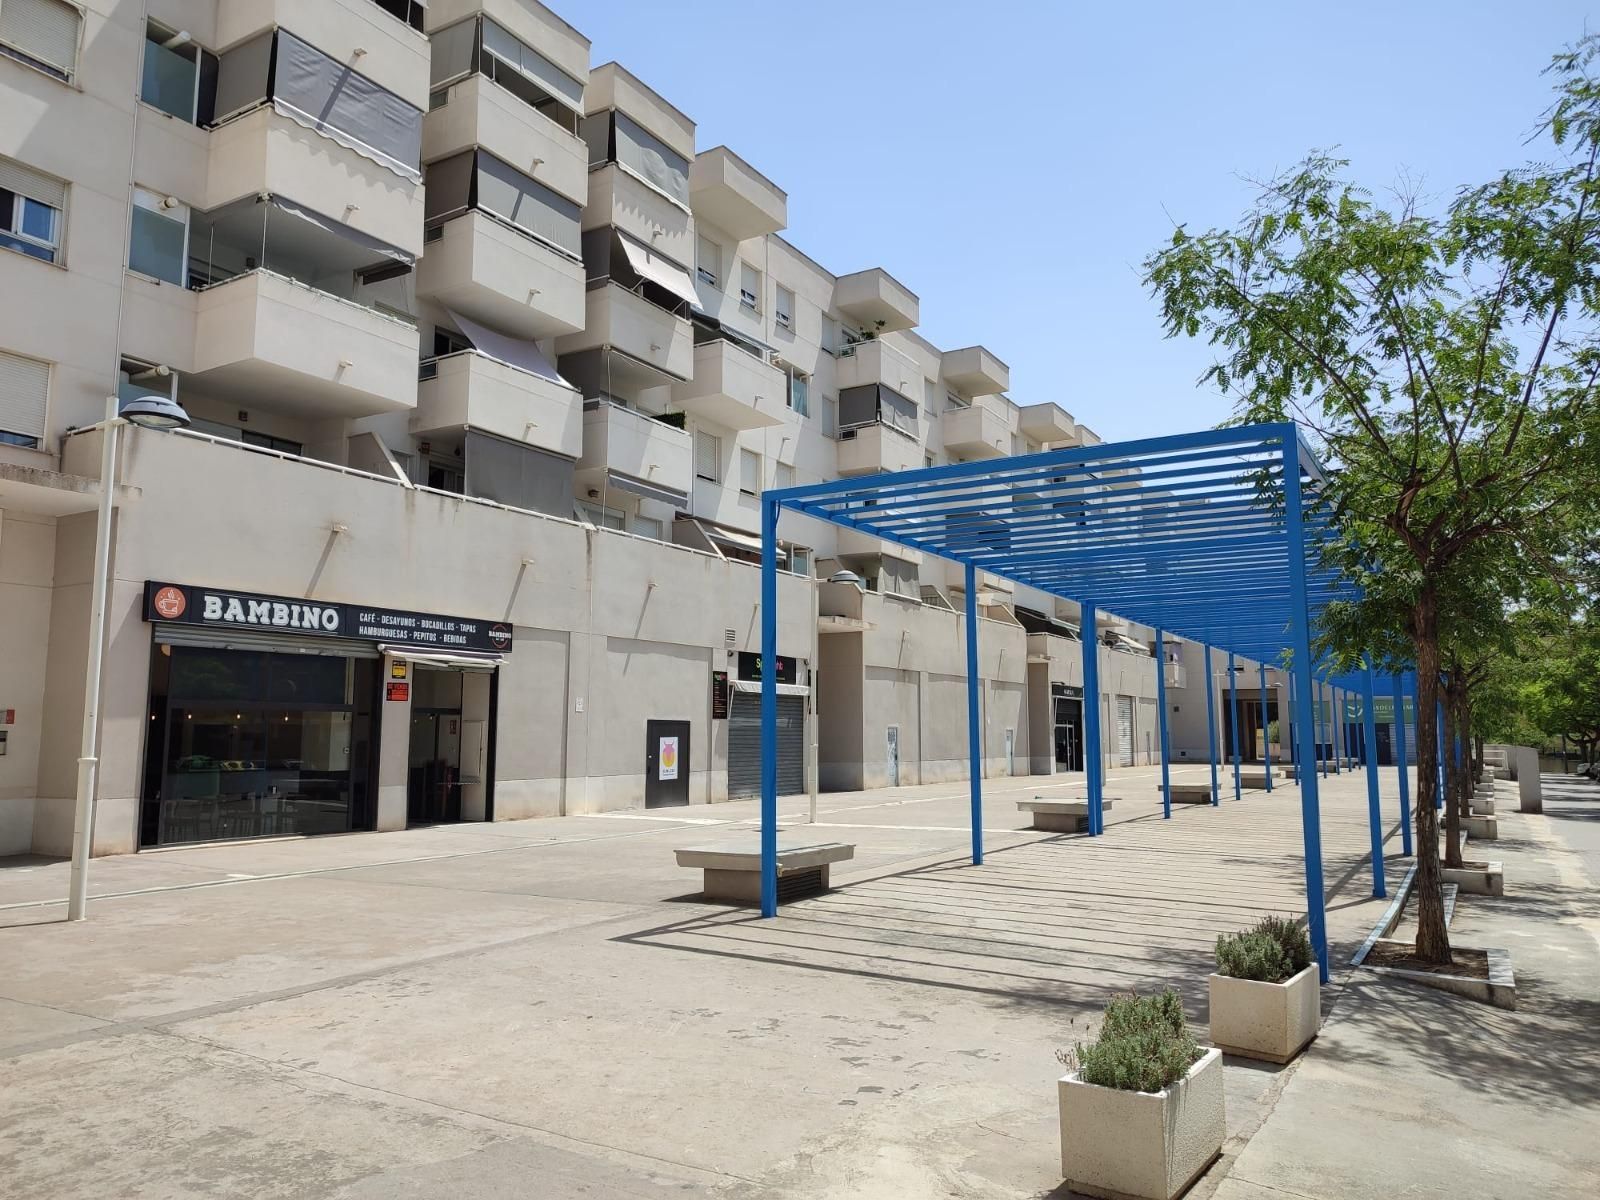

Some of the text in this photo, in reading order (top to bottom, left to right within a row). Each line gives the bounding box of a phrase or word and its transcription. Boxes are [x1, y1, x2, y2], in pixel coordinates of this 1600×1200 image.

[203, 595, 339, 631] BAMBINO
[359, 612, 477, 633] CAFÉ DESAYUNOS BOCADILLOS TAPAS
[359, 626, 467, 644] HAMBURGUESAS PEPITOS BEBIDAS
